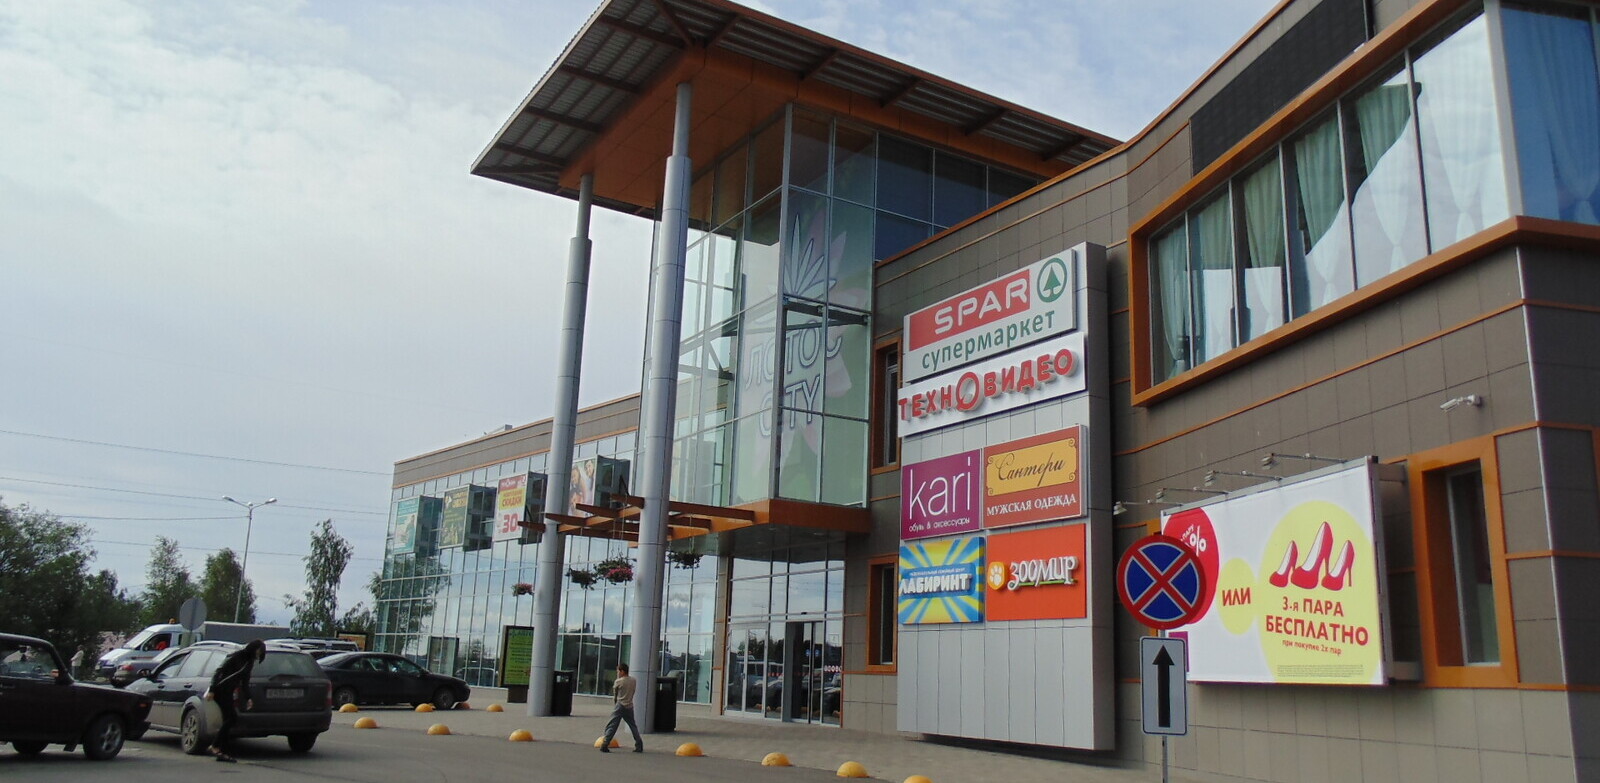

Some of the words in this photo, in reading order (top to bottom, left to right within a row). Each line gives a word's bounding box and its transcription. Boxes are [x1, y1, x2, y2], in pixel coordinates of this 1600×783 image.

[934, 278, 1028, 335] SPAR
[922, 310, 1055, 371] супермаркет
[898, 348, 1076, 421] ТЕХНОВИДЕО
[758, 373, 821, 438] CTY
[995, 452, 1066, 486] Сантери
[909, 456, 971, 520] kari
[987, 499, 1032, 517] МУЖСКАЯ
[1034, 493, 1077, 510] ОДЕЖДА
[909, 522, 925, 533] обувь
[899, 573, 970, 595] ЛАБИРИНТ
[1221, 587, 1252, 607] ИЛИ
[1282, 596, 1299, 611] 3-я
[1303, 598, 1344, 617] ПАРА
[1266, 615, 1369, 646] БЕСПЛАТНО
[1282, 639, 1293, 647] при
[1294, 641, 1320, 651] покупке
[1329, 647, 1342, 656] пар
